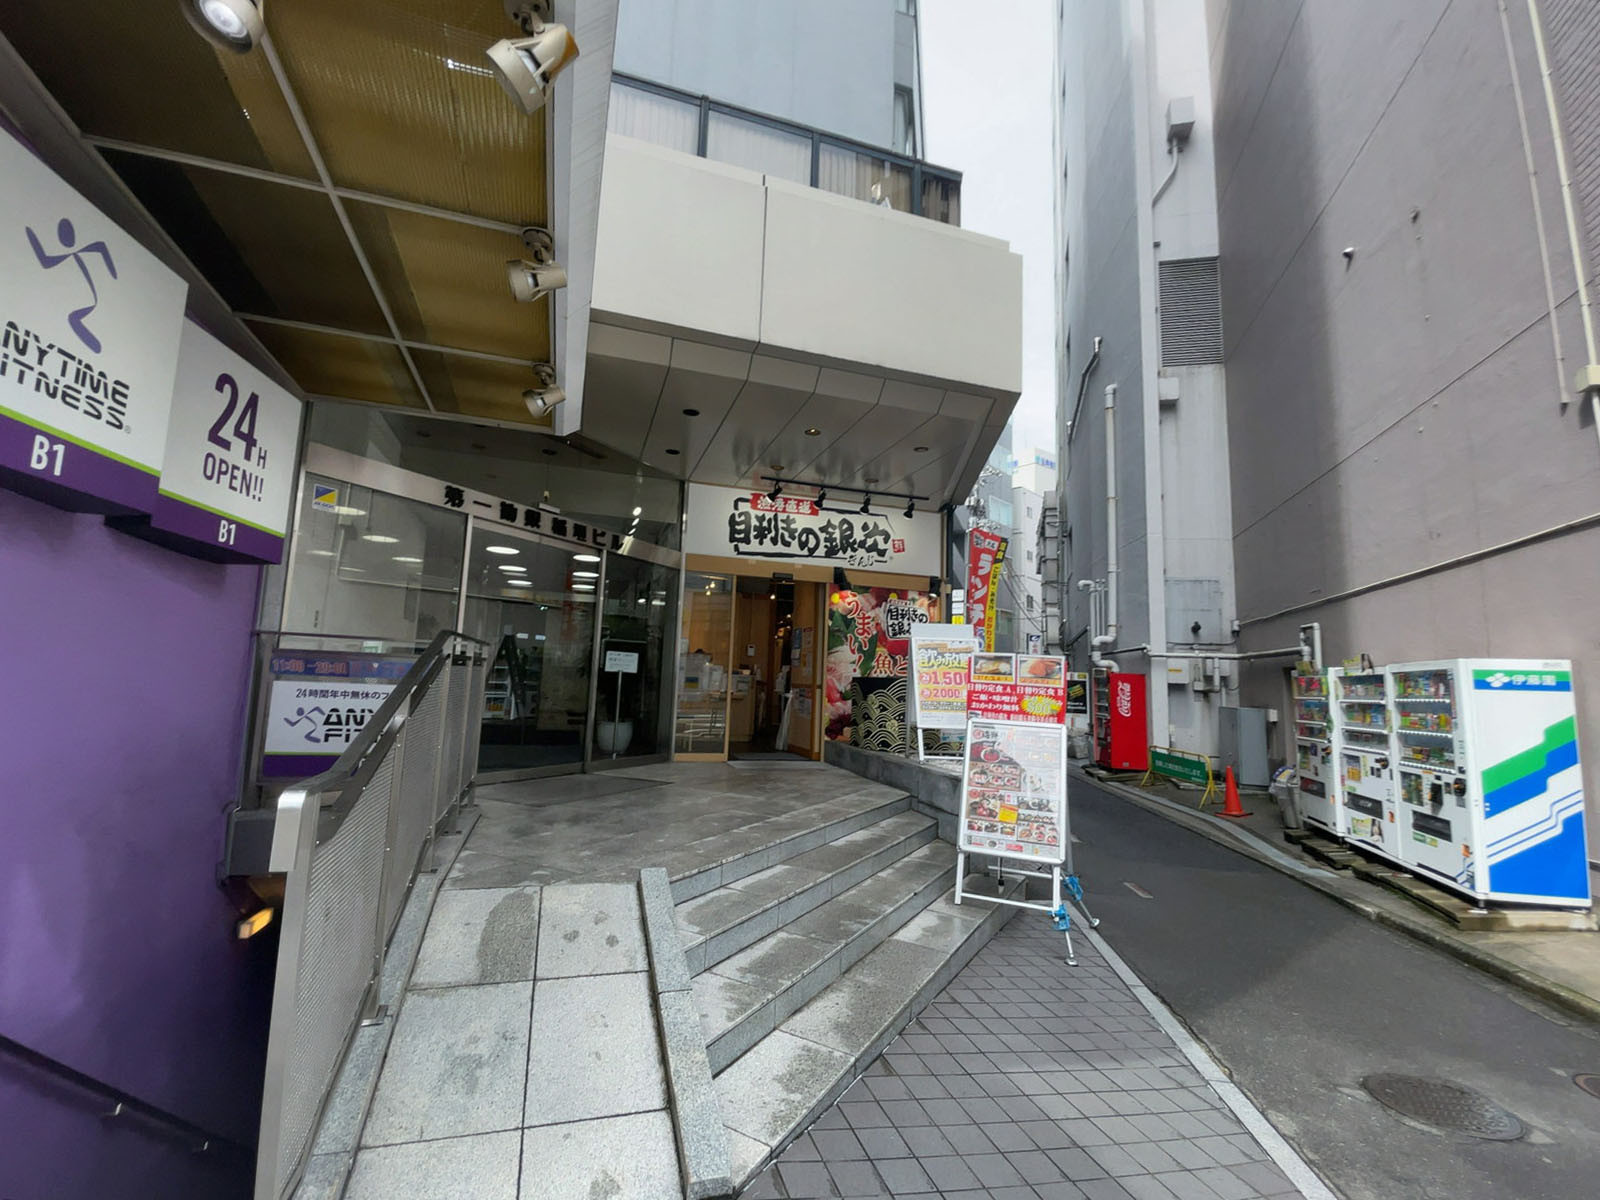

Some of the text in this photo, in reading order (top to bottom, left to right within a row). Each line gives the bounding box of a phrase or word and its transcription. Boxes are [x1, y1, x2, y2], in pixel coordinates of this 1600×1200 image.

[30, 434, 66, 476] B1
[203, 452, 264, 502] OPEN!!
[218, 520, 236, 545] B1
[728, 511, 891, 557] 目利きの銀次
[970, 553, 993, 625] ランチ
[322, 707, 375, 726] AN
[1116, 680, 1132, 717] Coca-Cola
